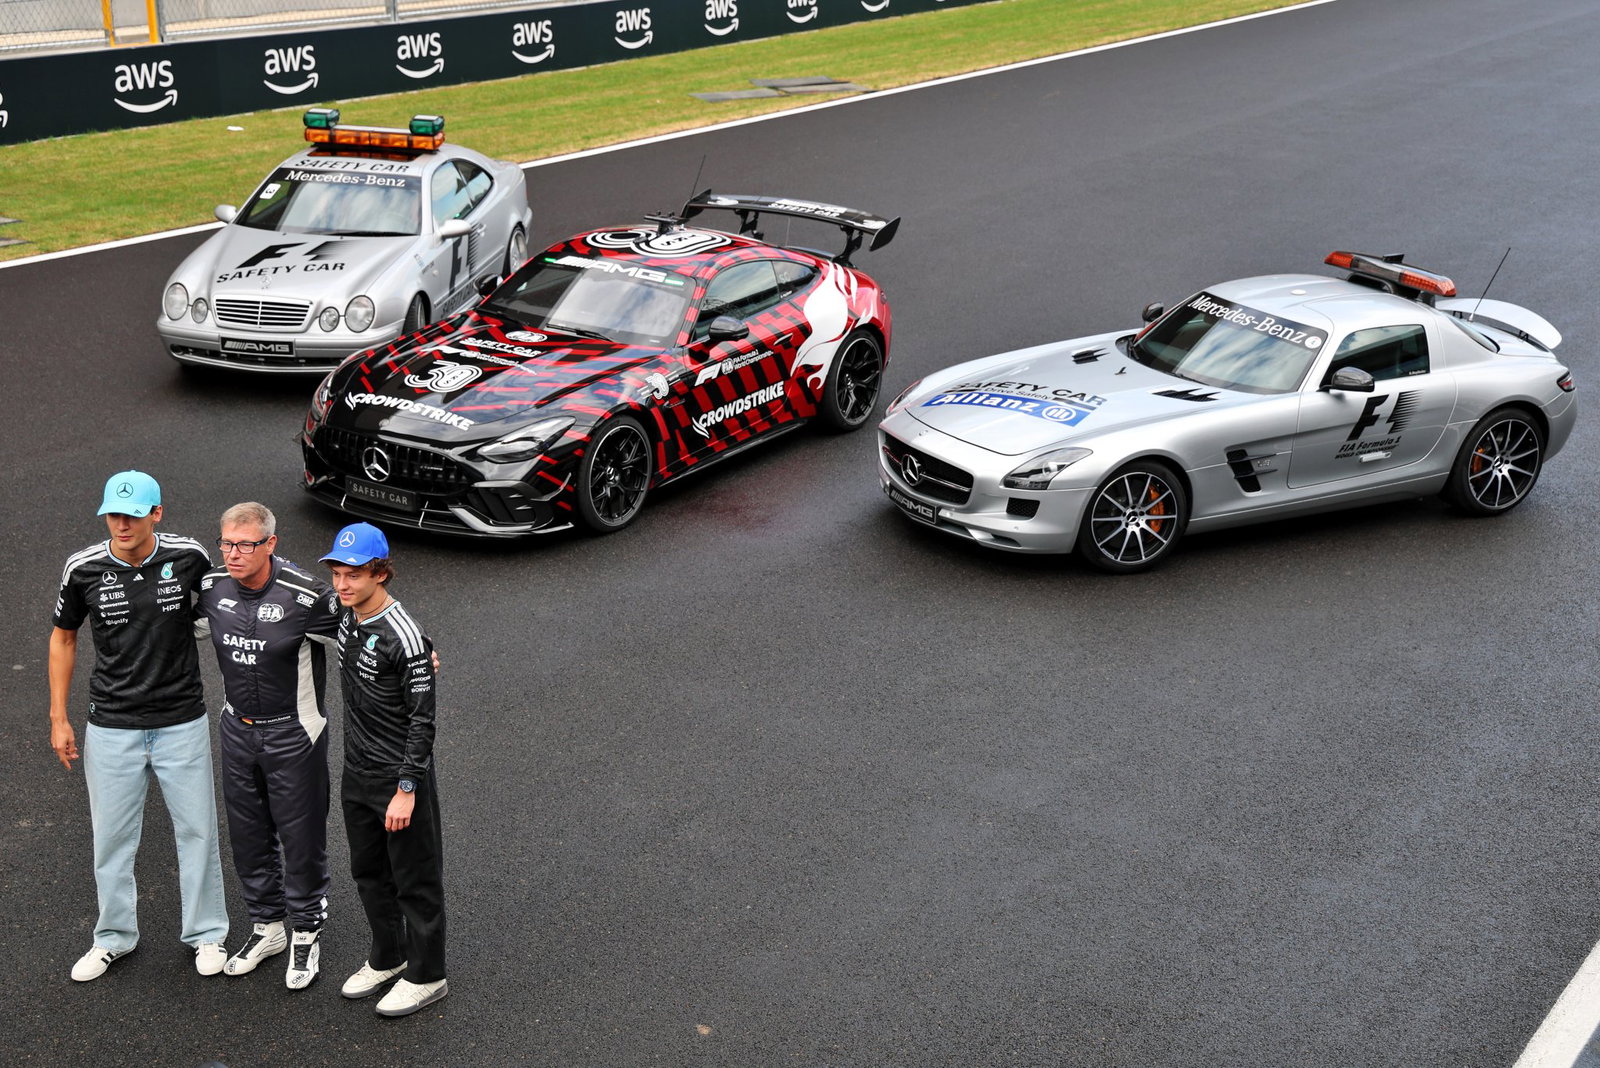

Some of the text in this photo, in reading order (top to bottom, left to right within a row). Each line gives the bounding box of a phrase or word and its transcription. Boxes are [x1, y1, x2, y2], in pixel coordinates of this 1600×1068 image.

[615, 7, 651, 34] aws
[705, 0, 738, 20] aws
[513, 19, 553, 46] aws
[397, 31, 442, 60] aws
[264, 45, 316, 75] aws
[114, 60, 174, 93] aws
[295, 159, 411, 173] SAFETY CAR
[285, 170, 407, 187] Mercedes-Benz
[216, 262, 346, 283] SAFETY CAR
[580, 259, 668, 283] AMG
[1187, 295, 1308, 344] Mercedes-Benz
[243, 342, 290, 352] AMG
[404, 360, 483, 393] 30
[698, 380, 785, 428] CROWDSTRIKE
[932, 392, 1043, 412] Allianz
[951, 381, 1108, 407] SAFETY CAR
[354, 393, 475, 431] CROWDSTRIKE
[1346, 389, 1424, 442] F1
[1339, 442, 1356, 453] FIA
[1357, 438, 1394, 450] Formula
[353, 483, 408, 505] SAFETY CAR
[900, 497, 933, 518] AMG
[109, 591, 126, 600] UBS
[158, 584, 182, 596] INEOS
[297, 594, 315, 605] OMP
[162, 602, 181, 612] HPE
[258, 604, 283, 621] FIA
[223, 633, 267, 651] SAFETY
[232, 651, 257, 665] CAR
[359, 652, 378, 667] INEOS
